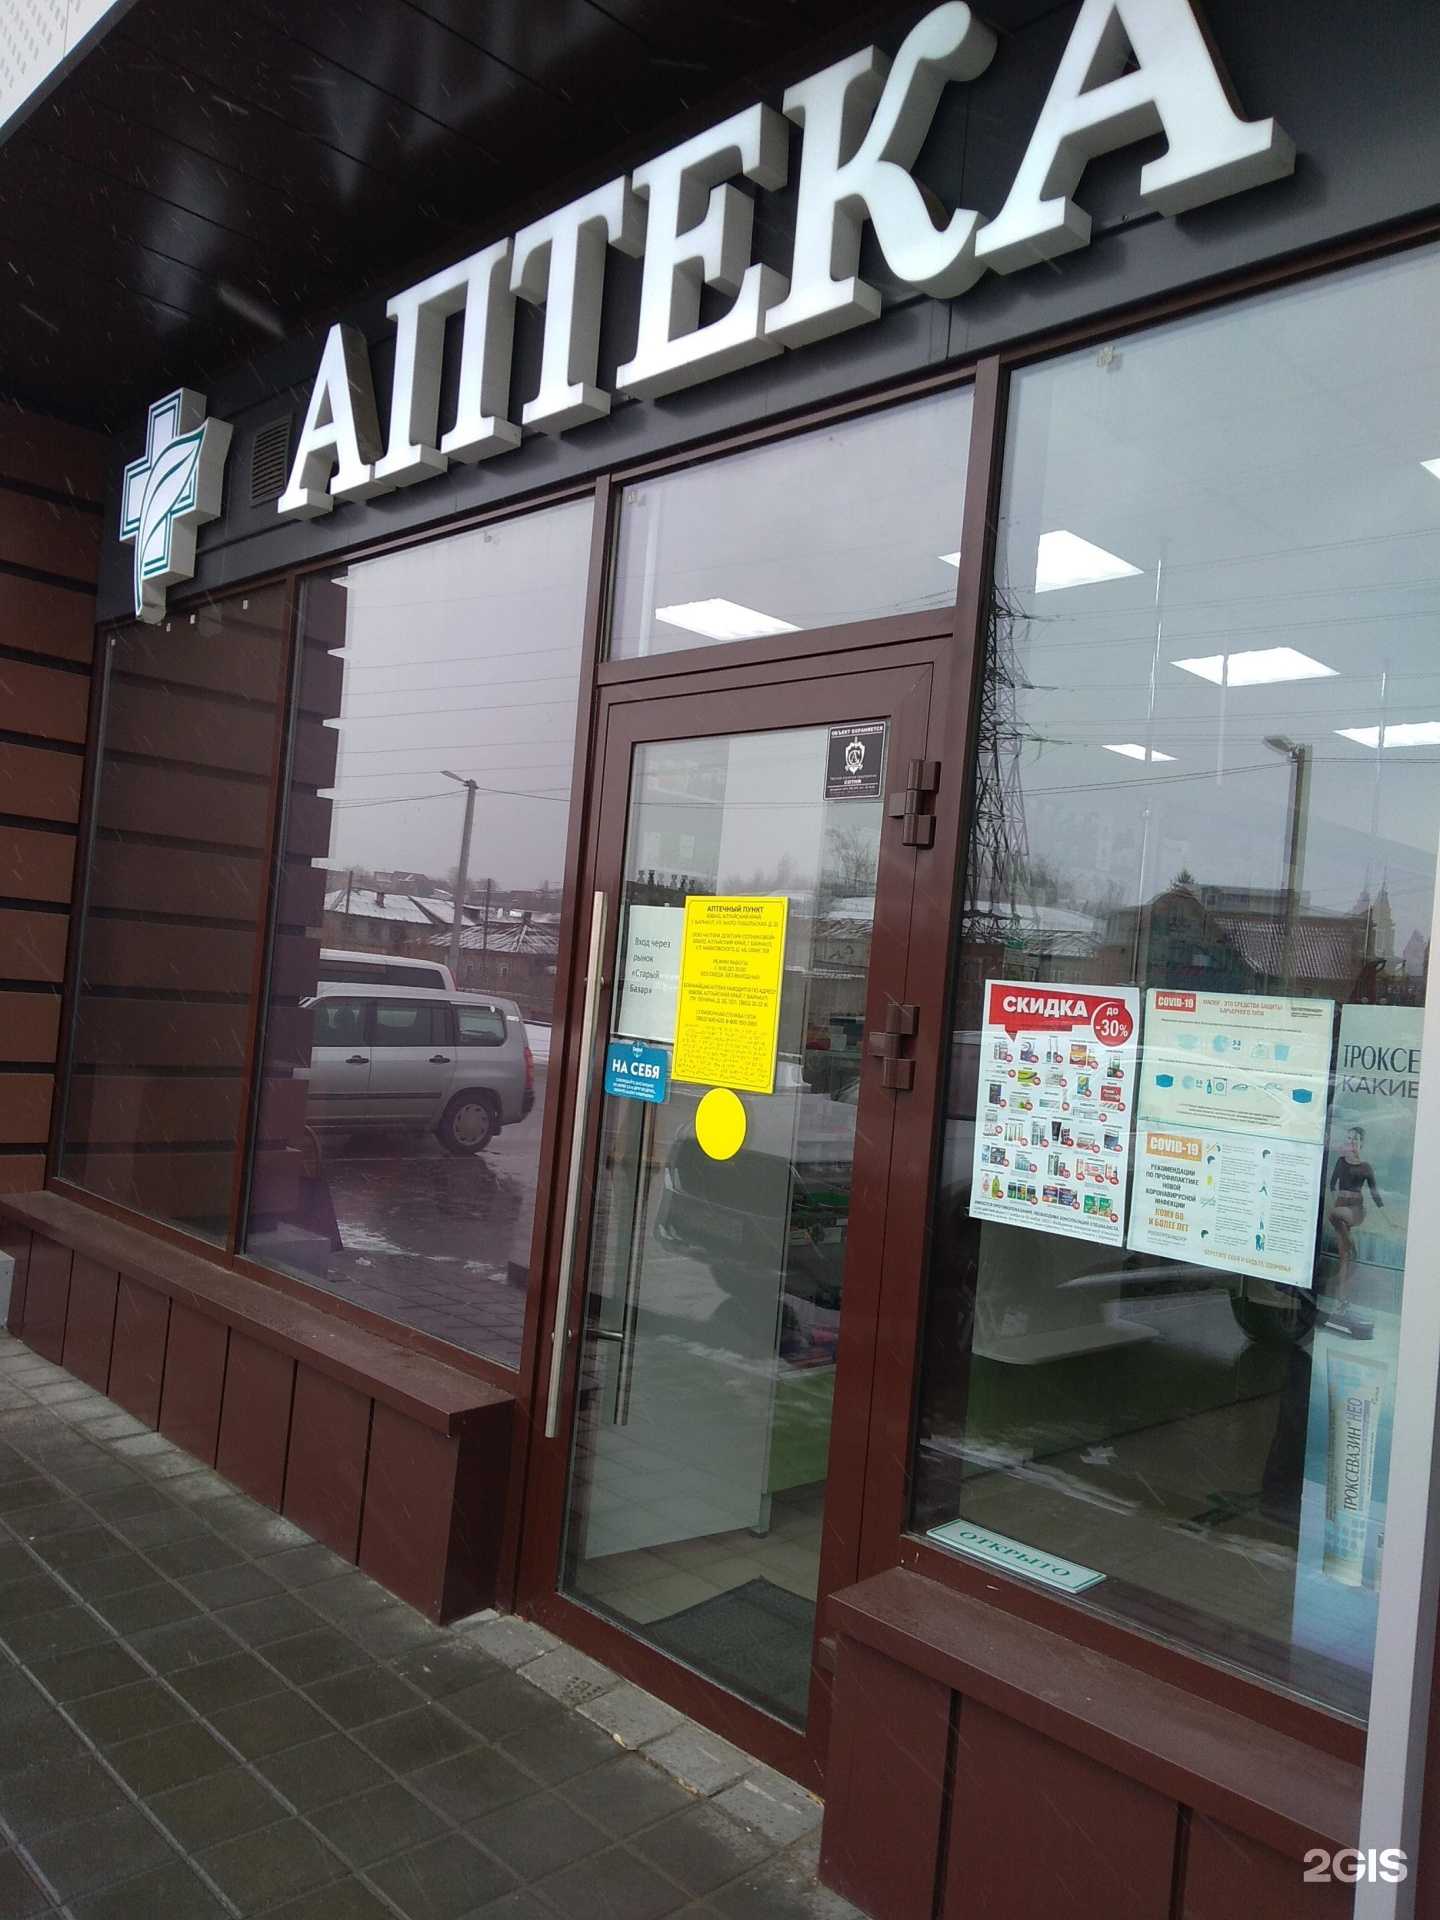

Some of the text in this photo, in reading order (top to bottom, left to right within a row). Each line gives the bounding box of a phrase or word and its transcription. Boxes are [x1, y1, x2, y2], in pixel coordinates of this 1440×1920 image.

[278, 0, 1285, 517] АПТЕКА
[707, 905, 742, 913] АПТЕЧНЫЙ
[633, 954, 654, 963] рынок
[1003, 996, 1088, 1018] СКИДКА
[1158, 997, 1194, 1009] COVID-19
[612, 1059, 660, 1079] НА СЕБЯ
[1344, 1045, 1421, 1073] ТРОКСЕ
[1343, 1075, 1420, 1099] КАКИЕ
[1151, 1137, 1199, 1156] COVID-19
[1151, 1164, 1196, 1176] РЕКОМЕНДАЦИИ
[960, 1530, 1070, 1577] ОТКРЫТО
